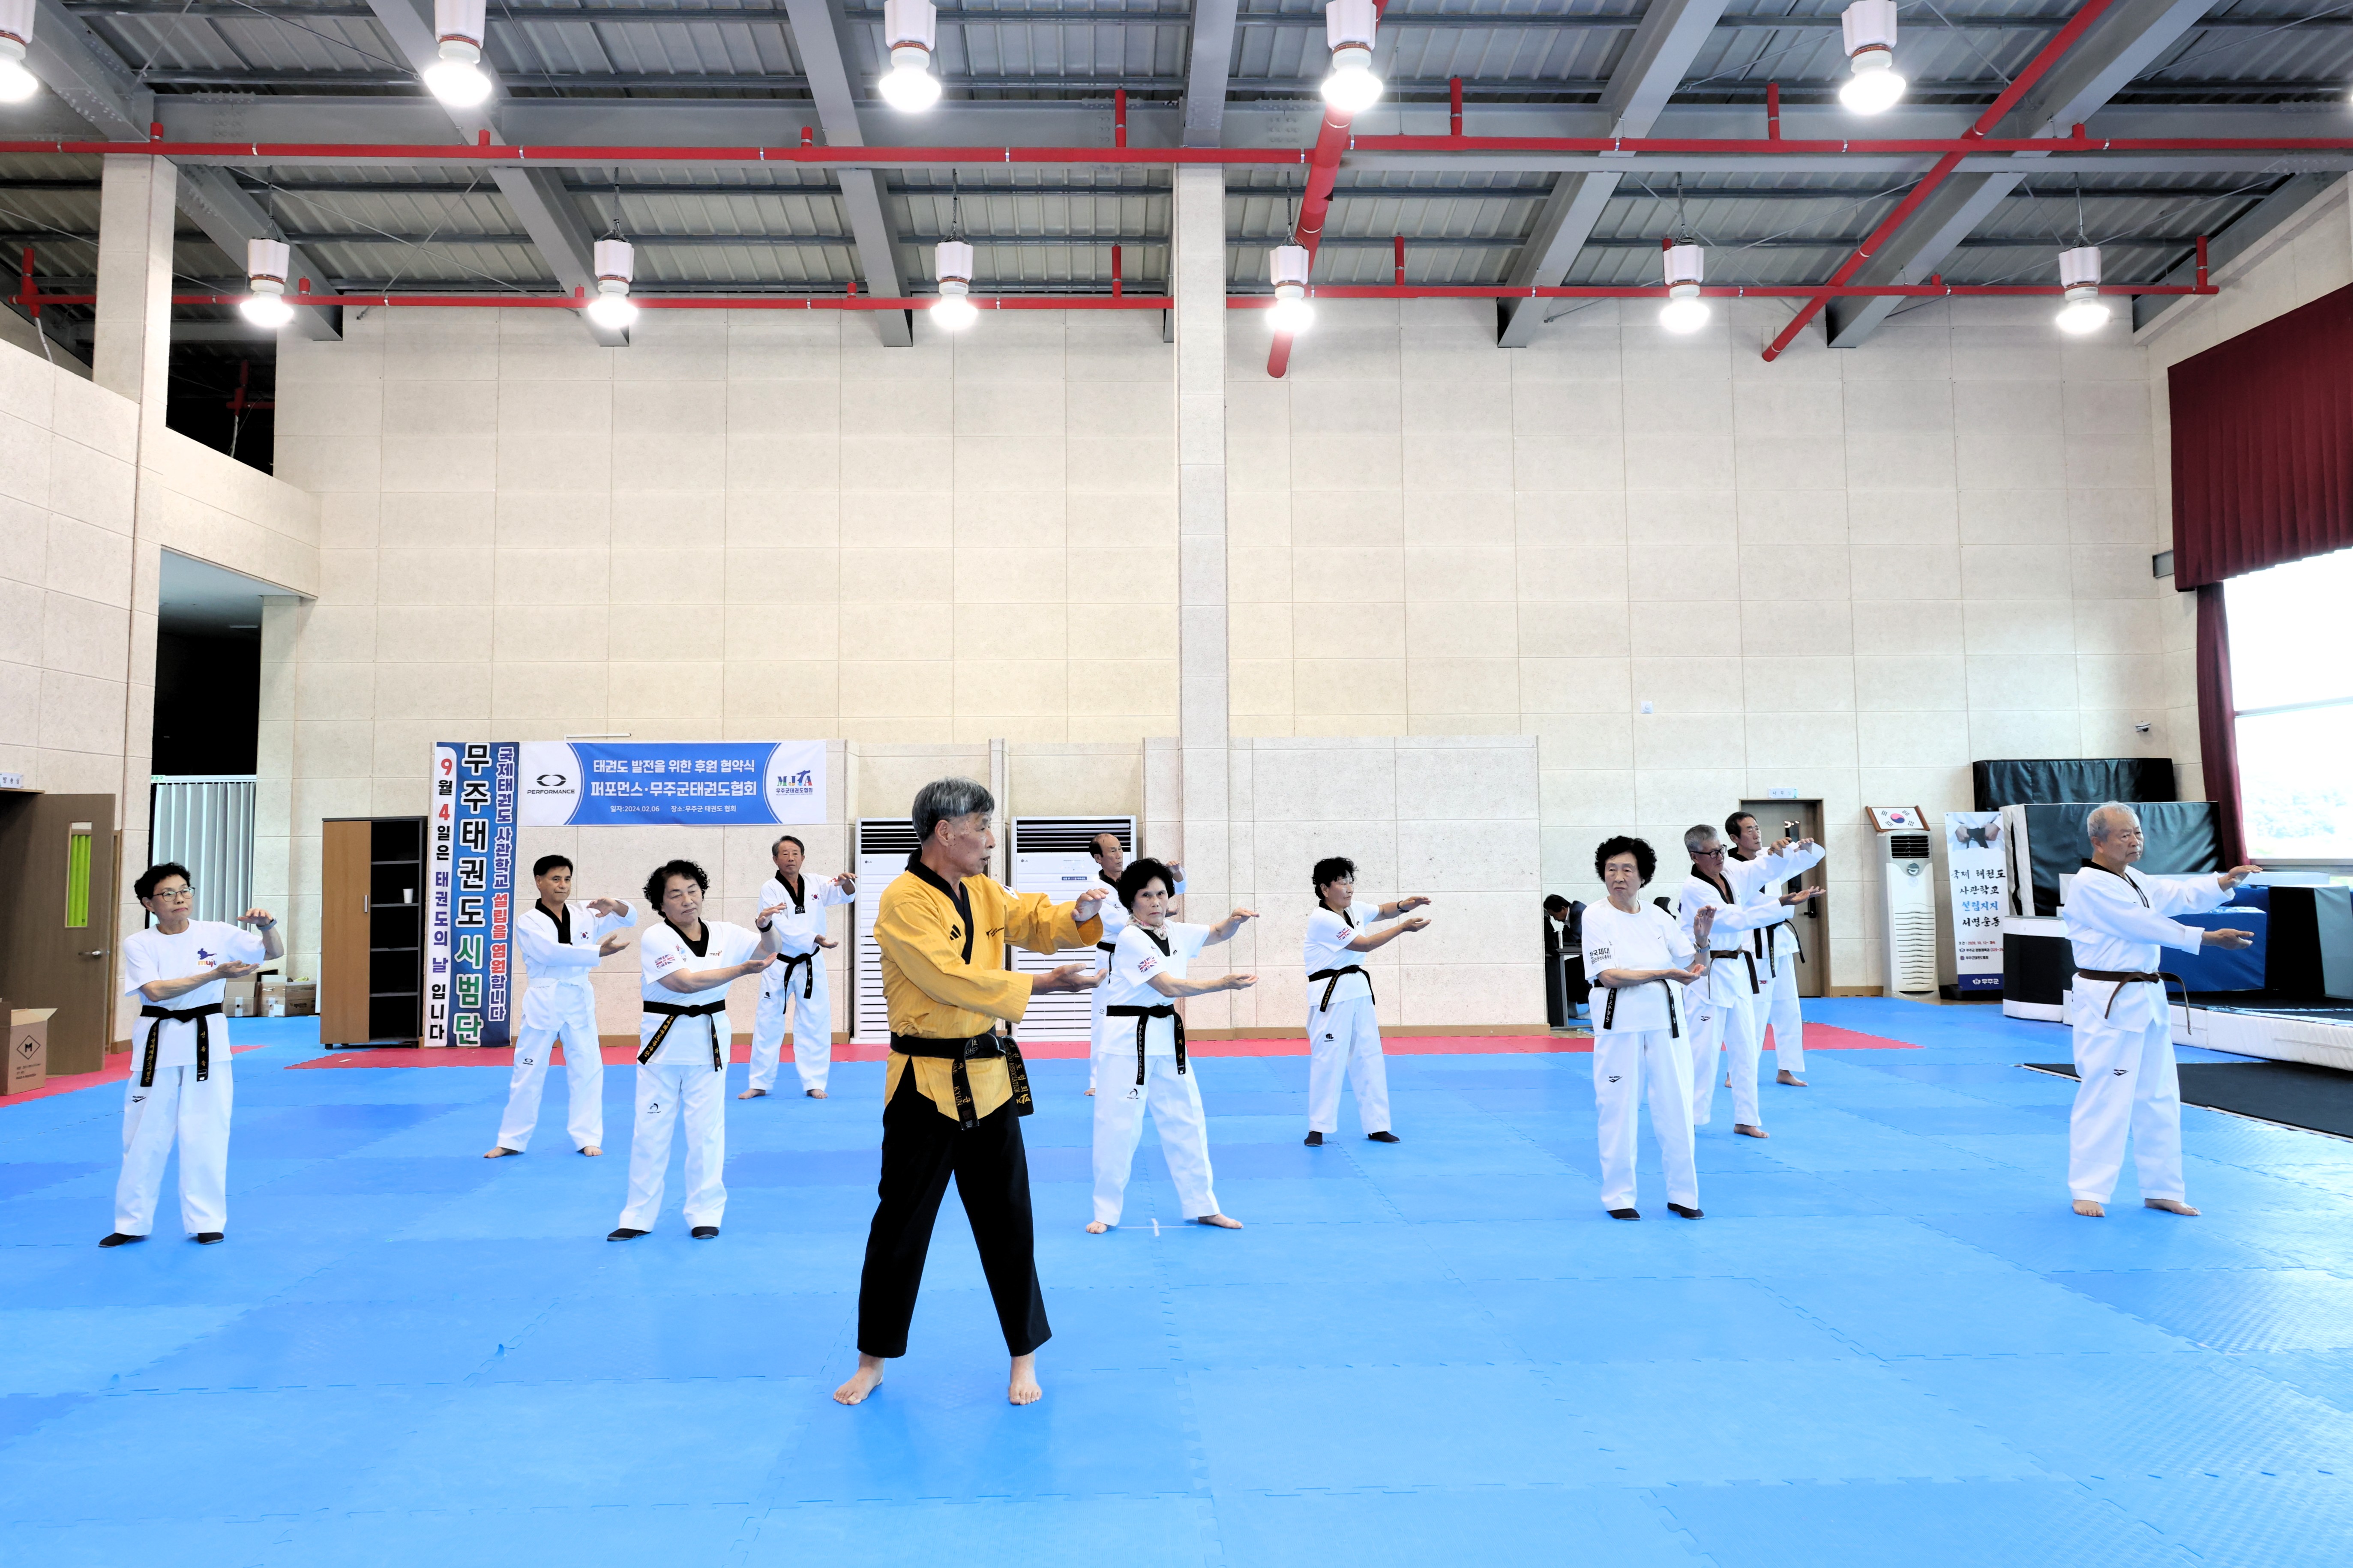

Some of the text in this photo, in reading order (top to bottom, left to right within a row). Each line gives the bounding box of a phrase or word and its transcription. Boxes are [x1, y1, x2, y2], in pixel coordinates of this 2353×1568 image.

[593, 759, 755, 773] 태권도 발전을 위한 후원 협약식
[776, 770, 813, 787] MJTA
[1951, 869, 2006, 879] 국제 태권도
[490, 748, 513, 1020] 국제태권도 사관학교 설립을 염원합니다
[1960, 885, 1999, 895] 사관학교
[430, 758, 453, 1039] 9월 4일은 태권도의 날 입니다
[1962, 901, 1999, 912] 설립지지
[1962, 916, 2000, 927] 서명운동
[965, 1047, 978, 1055] CHO
[1009, 1062, 1020, 1093] ASSOCIATION
[954, 1086, 963, 1106] KYUN
[1016, 1093, 1031, 1104] KTA
